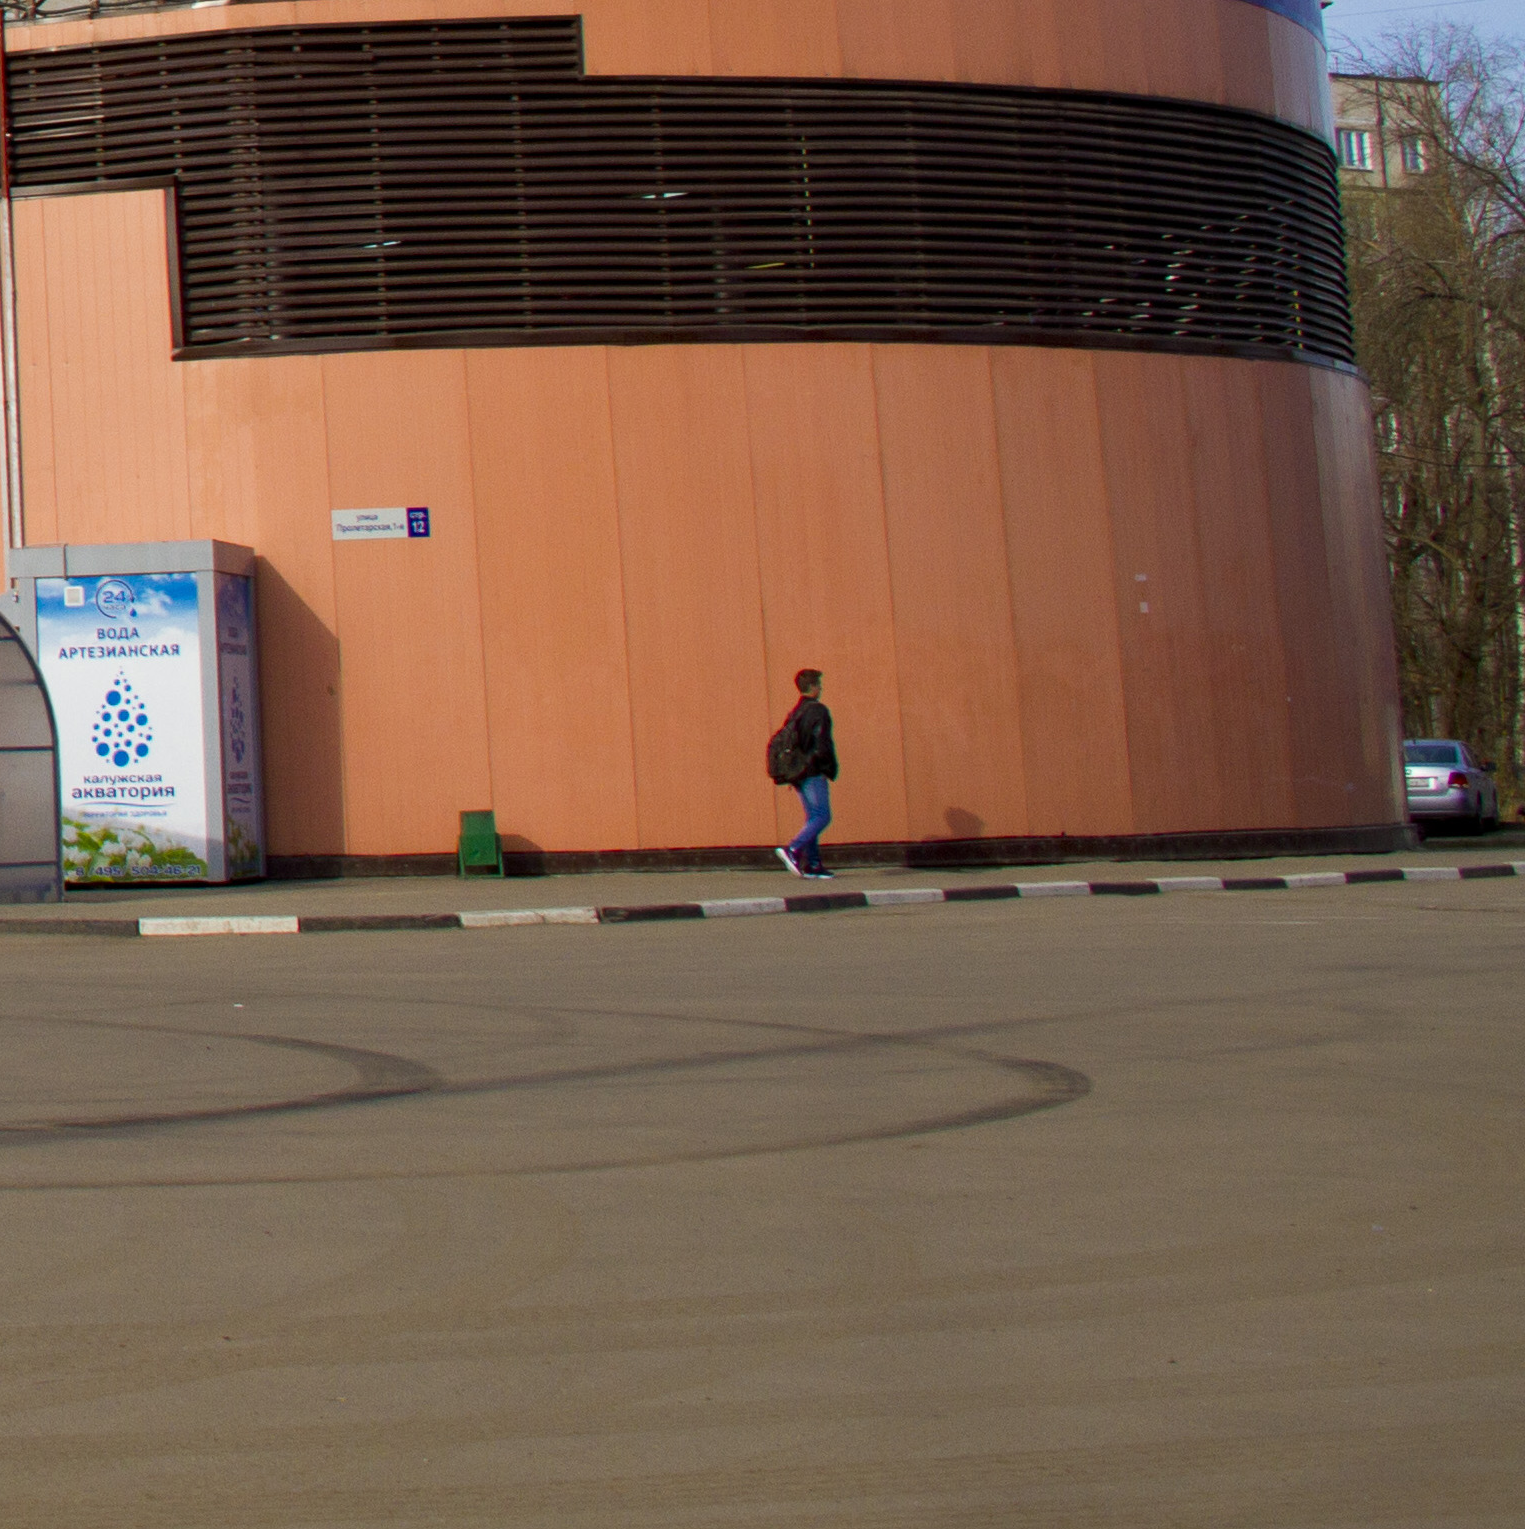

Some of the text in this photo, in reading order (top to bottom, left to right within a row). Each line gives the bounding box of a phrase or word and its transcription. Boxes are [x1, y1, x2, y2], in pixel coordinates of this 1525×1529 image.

[412, 520, 425, 533] 12
[102, 590, 126, 603] 24
[96, 626, 140, 641] ВОДА
[58, 643, 181, 660] АРТЕЗИАНСКАЯ
[83, 774, 162, 786] калужская
[72, 785, 176, 800] акватория
